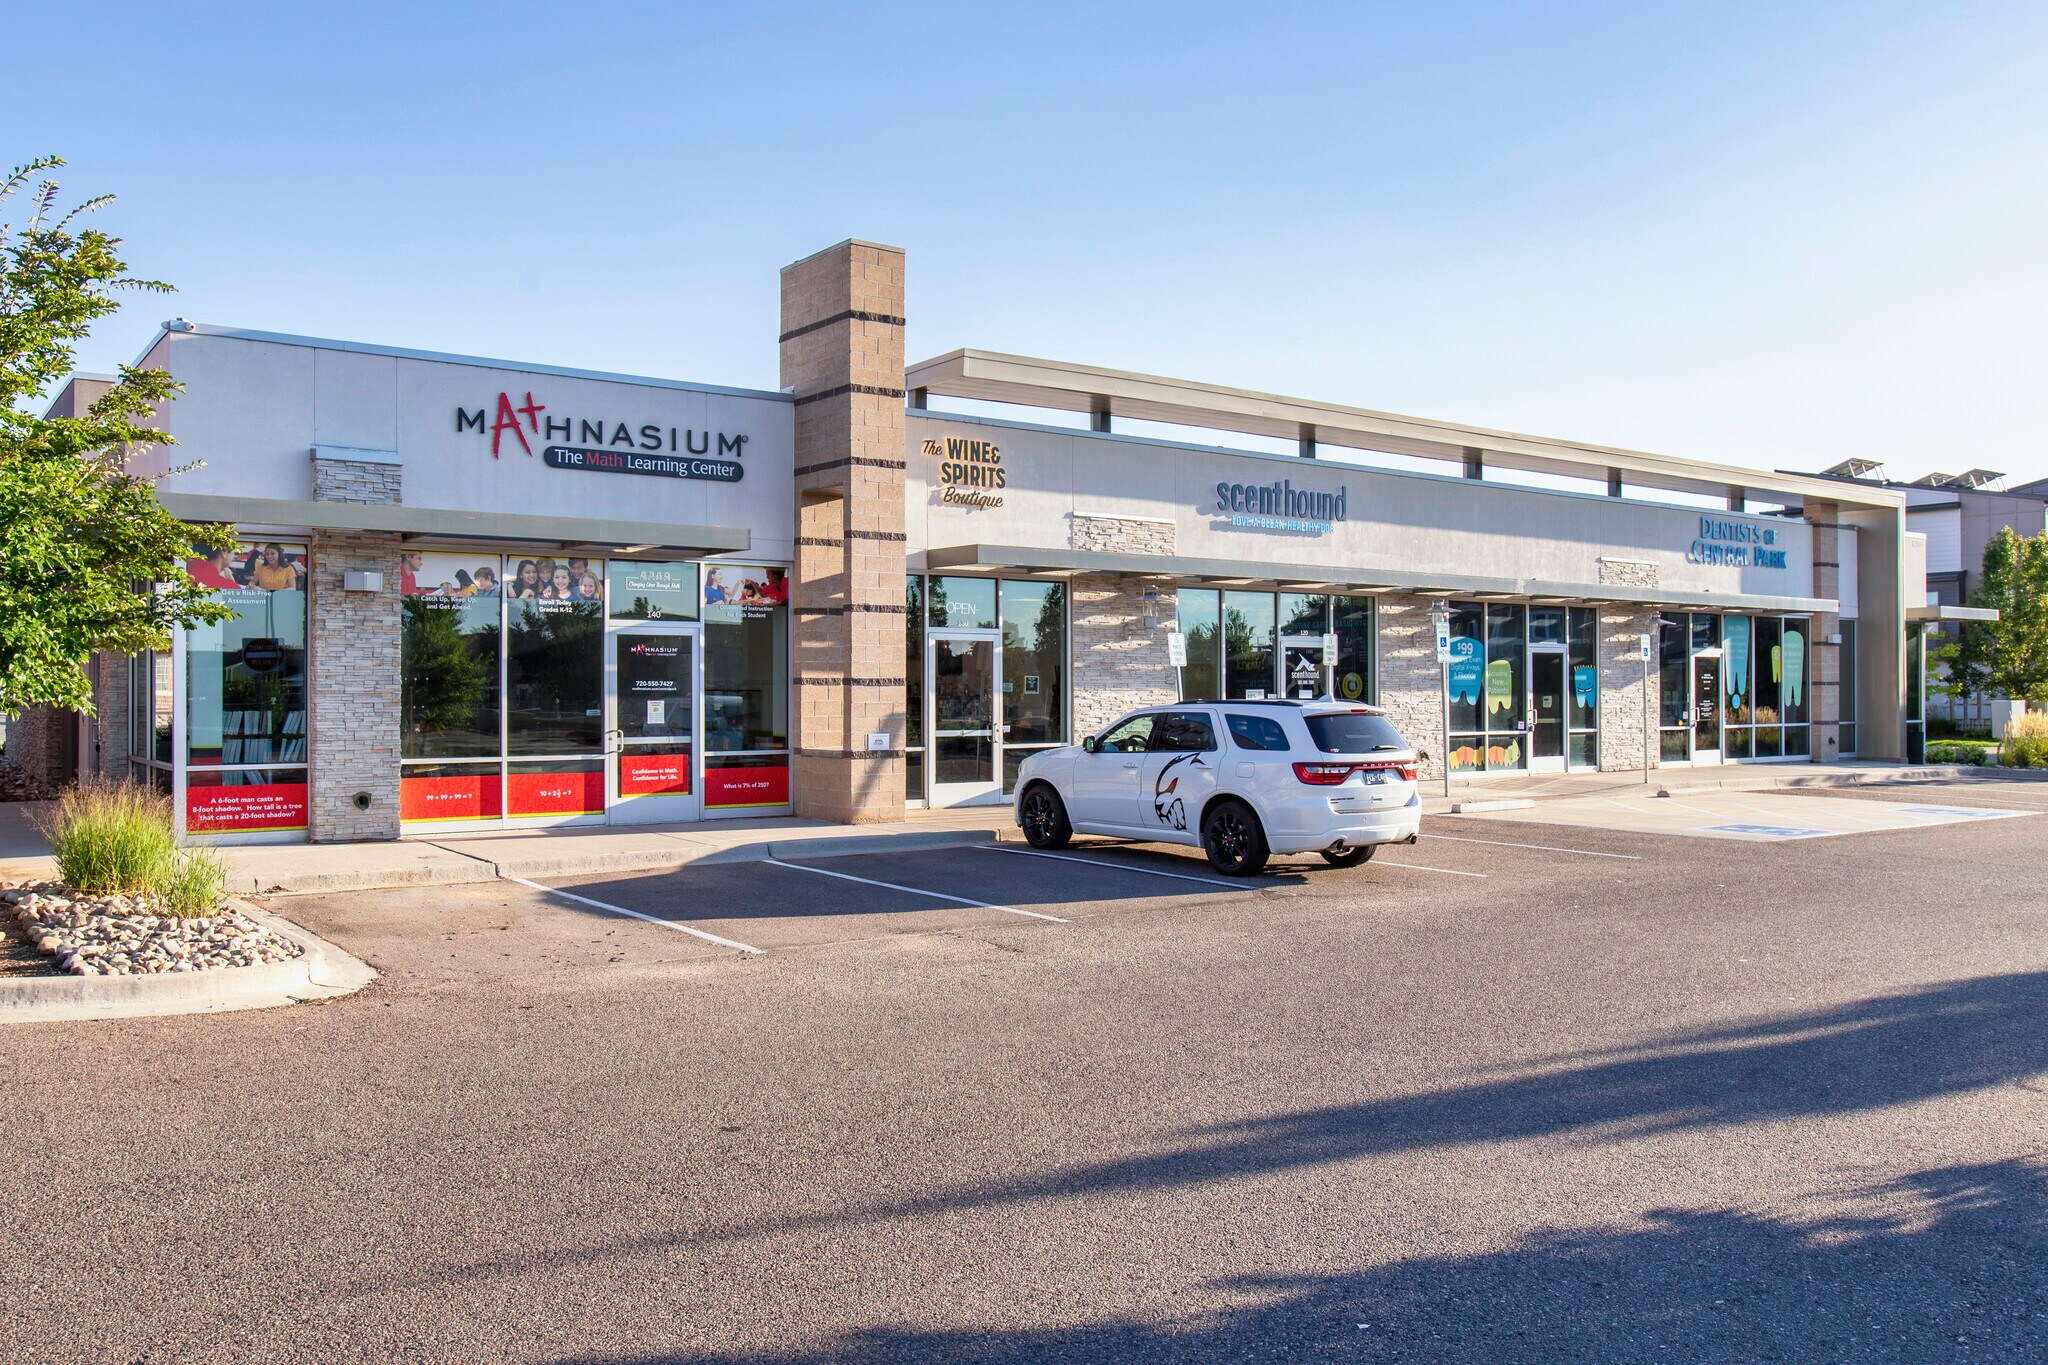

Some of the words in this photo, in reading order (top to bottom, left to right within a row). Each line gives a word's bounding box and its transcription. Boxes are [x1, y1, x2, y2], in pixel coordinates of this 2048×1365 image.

[923, 439, 943, 456] The
[946, 437, 1001, 465] WINE&
[554, 448, 583, 465] The
[586, 451, 623, 468] Math
[627, 455, 688, 477] Learning
[691, 461, 735, 477] Center
[941, 461, 1006, 489] SPIRITS
[943, 486, 1004, 511] Boutique
[1216, 479, 1347, 522] scenthound
[1231, 515, 1251, 526] LOVE
[1253, 516, 1259, 527] A
[1287, 520, 1319, 533] HEALTHY
[1700, 515, 1762, 544] DENTISTS
[1763, 528, 1778, 545] OF
[1692, 539, 1749, 566] CENTRAL
[1754, 545, 1787, 569] PARK
[221, 589, 236, 597] Get
[242, 589, 272, 597] Risk-Free
[450, 596, 466, 604] Keep
[227, 597, 267, 605] Assessment
[451, 603, 472, 611] Ahead.
[946, 602, 976, 615] OPEN
[646, 610, 661, 618] 140
[1457, 642, 1474, 655] $99
[1291, 670, 1320, 679] scenthound
